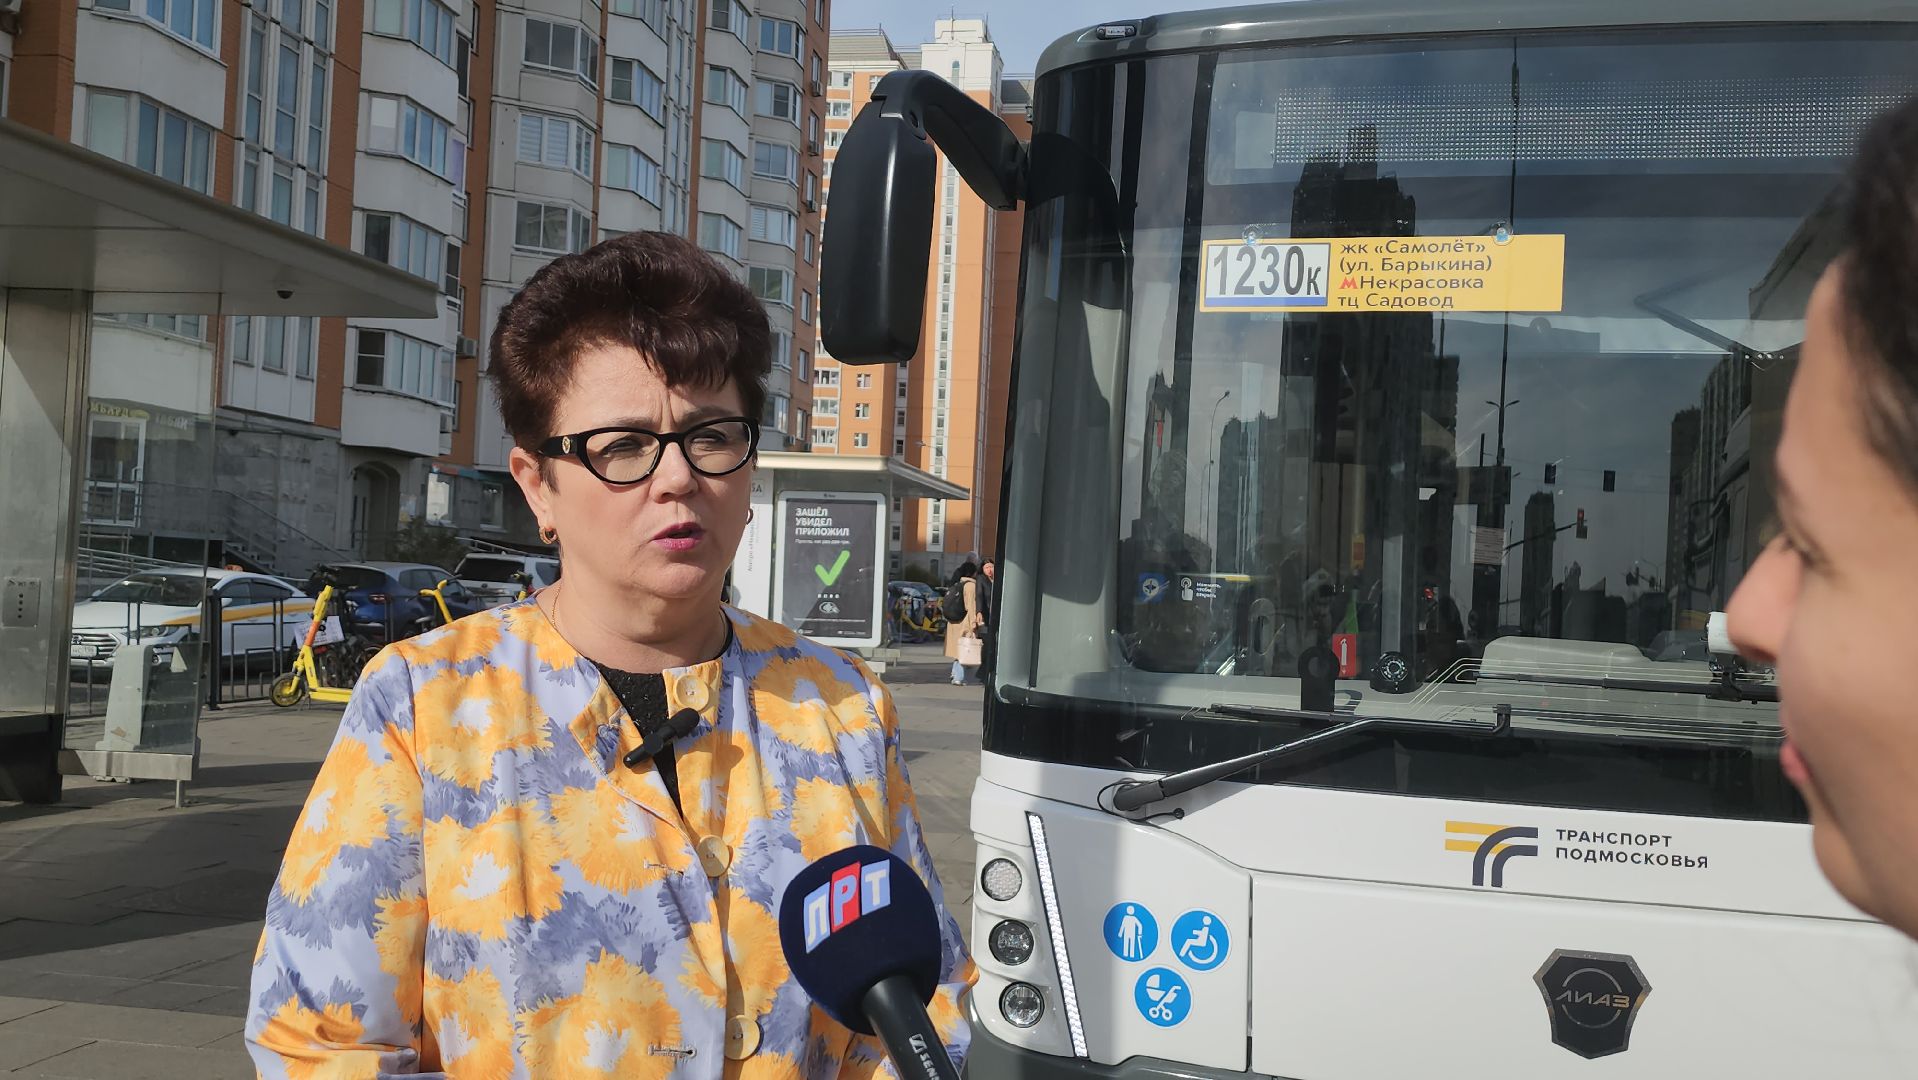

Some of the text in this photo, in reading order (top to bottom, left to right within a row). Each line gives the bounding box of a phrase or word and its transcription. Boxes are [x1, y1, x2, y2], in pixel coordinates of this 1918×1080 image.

[1340, 239, 1486, 254] жк «Самолёт»
[1340, 255, 1492, 275] (ул. Барыкина)
[1337, 293, 1454, 309] тц Садовод
[795, 506, 829, 517] ЗАШЁЛ
[795, 517, 833, 528] УВИДЕЛ
[795, 527, 850, 537] ПРИЛОЖИЛ
[1555, 828, 1673, 848] ТРАНСПОРТ
[1555, 847, 1709, 869] ПОДМОСКОВЬЯ
[1555, 989, 1630, 1009] ЛИАЗ
